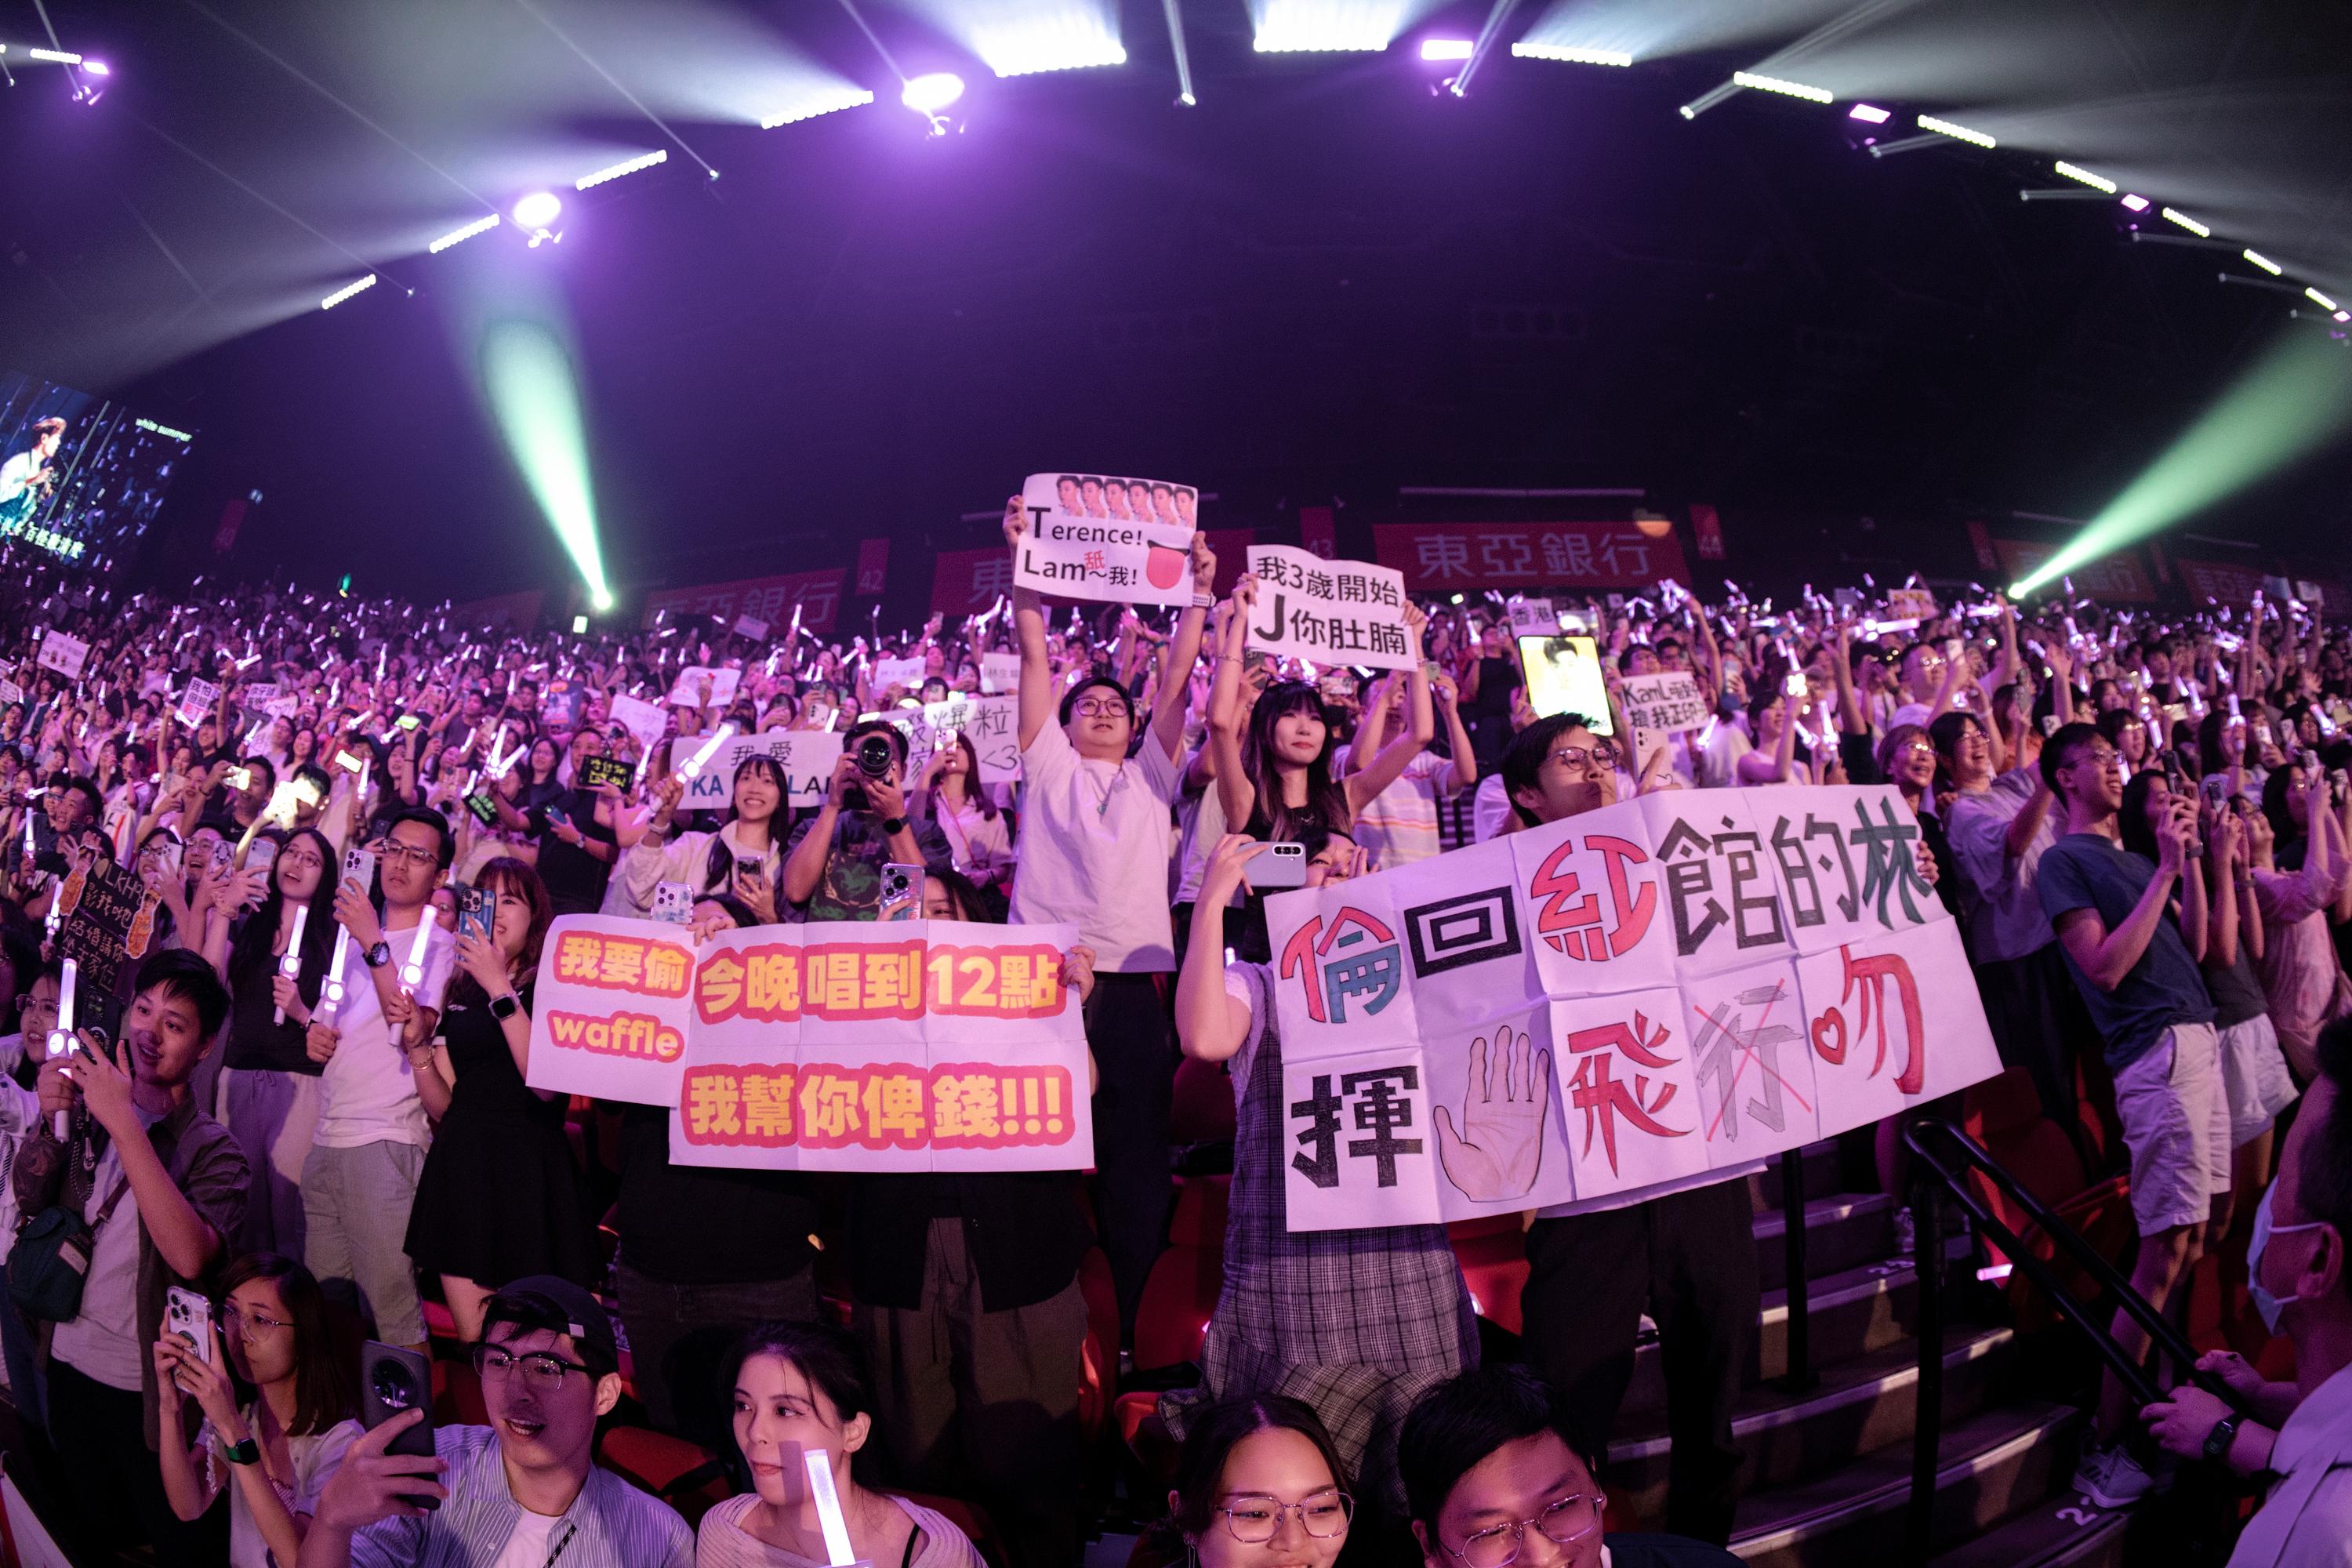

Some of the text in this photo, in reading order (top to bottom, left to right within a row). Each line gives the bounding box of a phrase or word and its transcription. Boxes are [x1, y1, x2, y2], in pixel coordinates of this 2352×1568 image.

[1027, 506, 1142, 546] Terence!
[1257, 556, 1399, 608] 我3歲開始
[1414, 532, 1650, 579] 東亞銀行
[1254, 593, 1407, 655] J你肚腩
[560, 935, 688, 993] 我要偷
[699, 949, 1062, 1015] 今晚唱到12點
[553, 1015, 681, 1058] waffle
[689, 1073, 1065, 1139] 我幫你俾錢!!!
